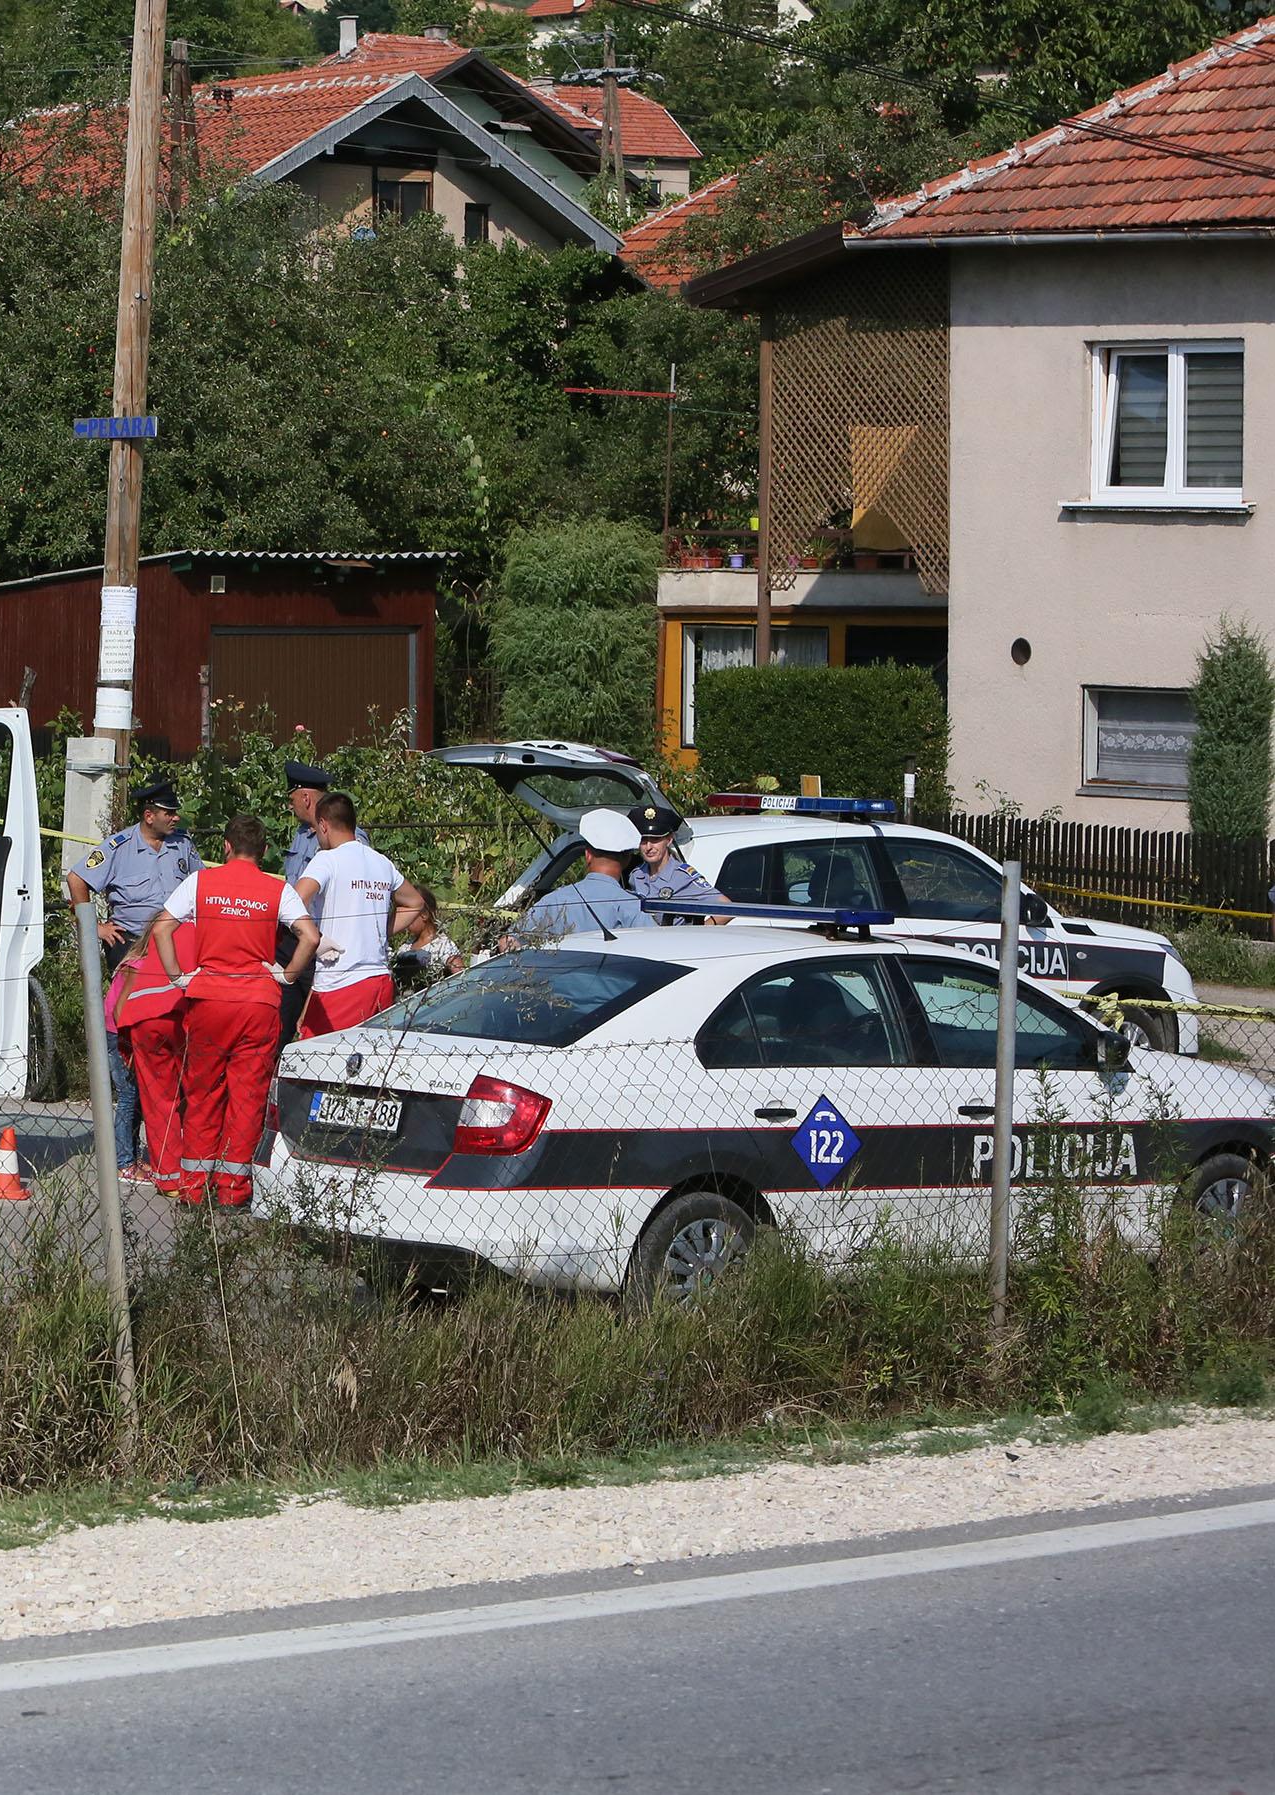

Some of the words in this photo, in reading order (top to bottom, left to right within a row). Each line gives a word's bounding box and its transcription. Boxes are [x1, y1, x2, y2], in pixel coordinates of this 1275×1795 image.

[87, 416, 156, 438] PEKARA
[762, 797, 795, 808] POLICIJA
[351, 879, 372, 890] HITNA
[373, 881, 392, 892] POMO
[205, 896, 231, 906] HITNA
[235, 898, 269, 912] POMOĆ
[220, 906, 251, 918] ZENICA
[809, 1129, 845, 1164] 122
